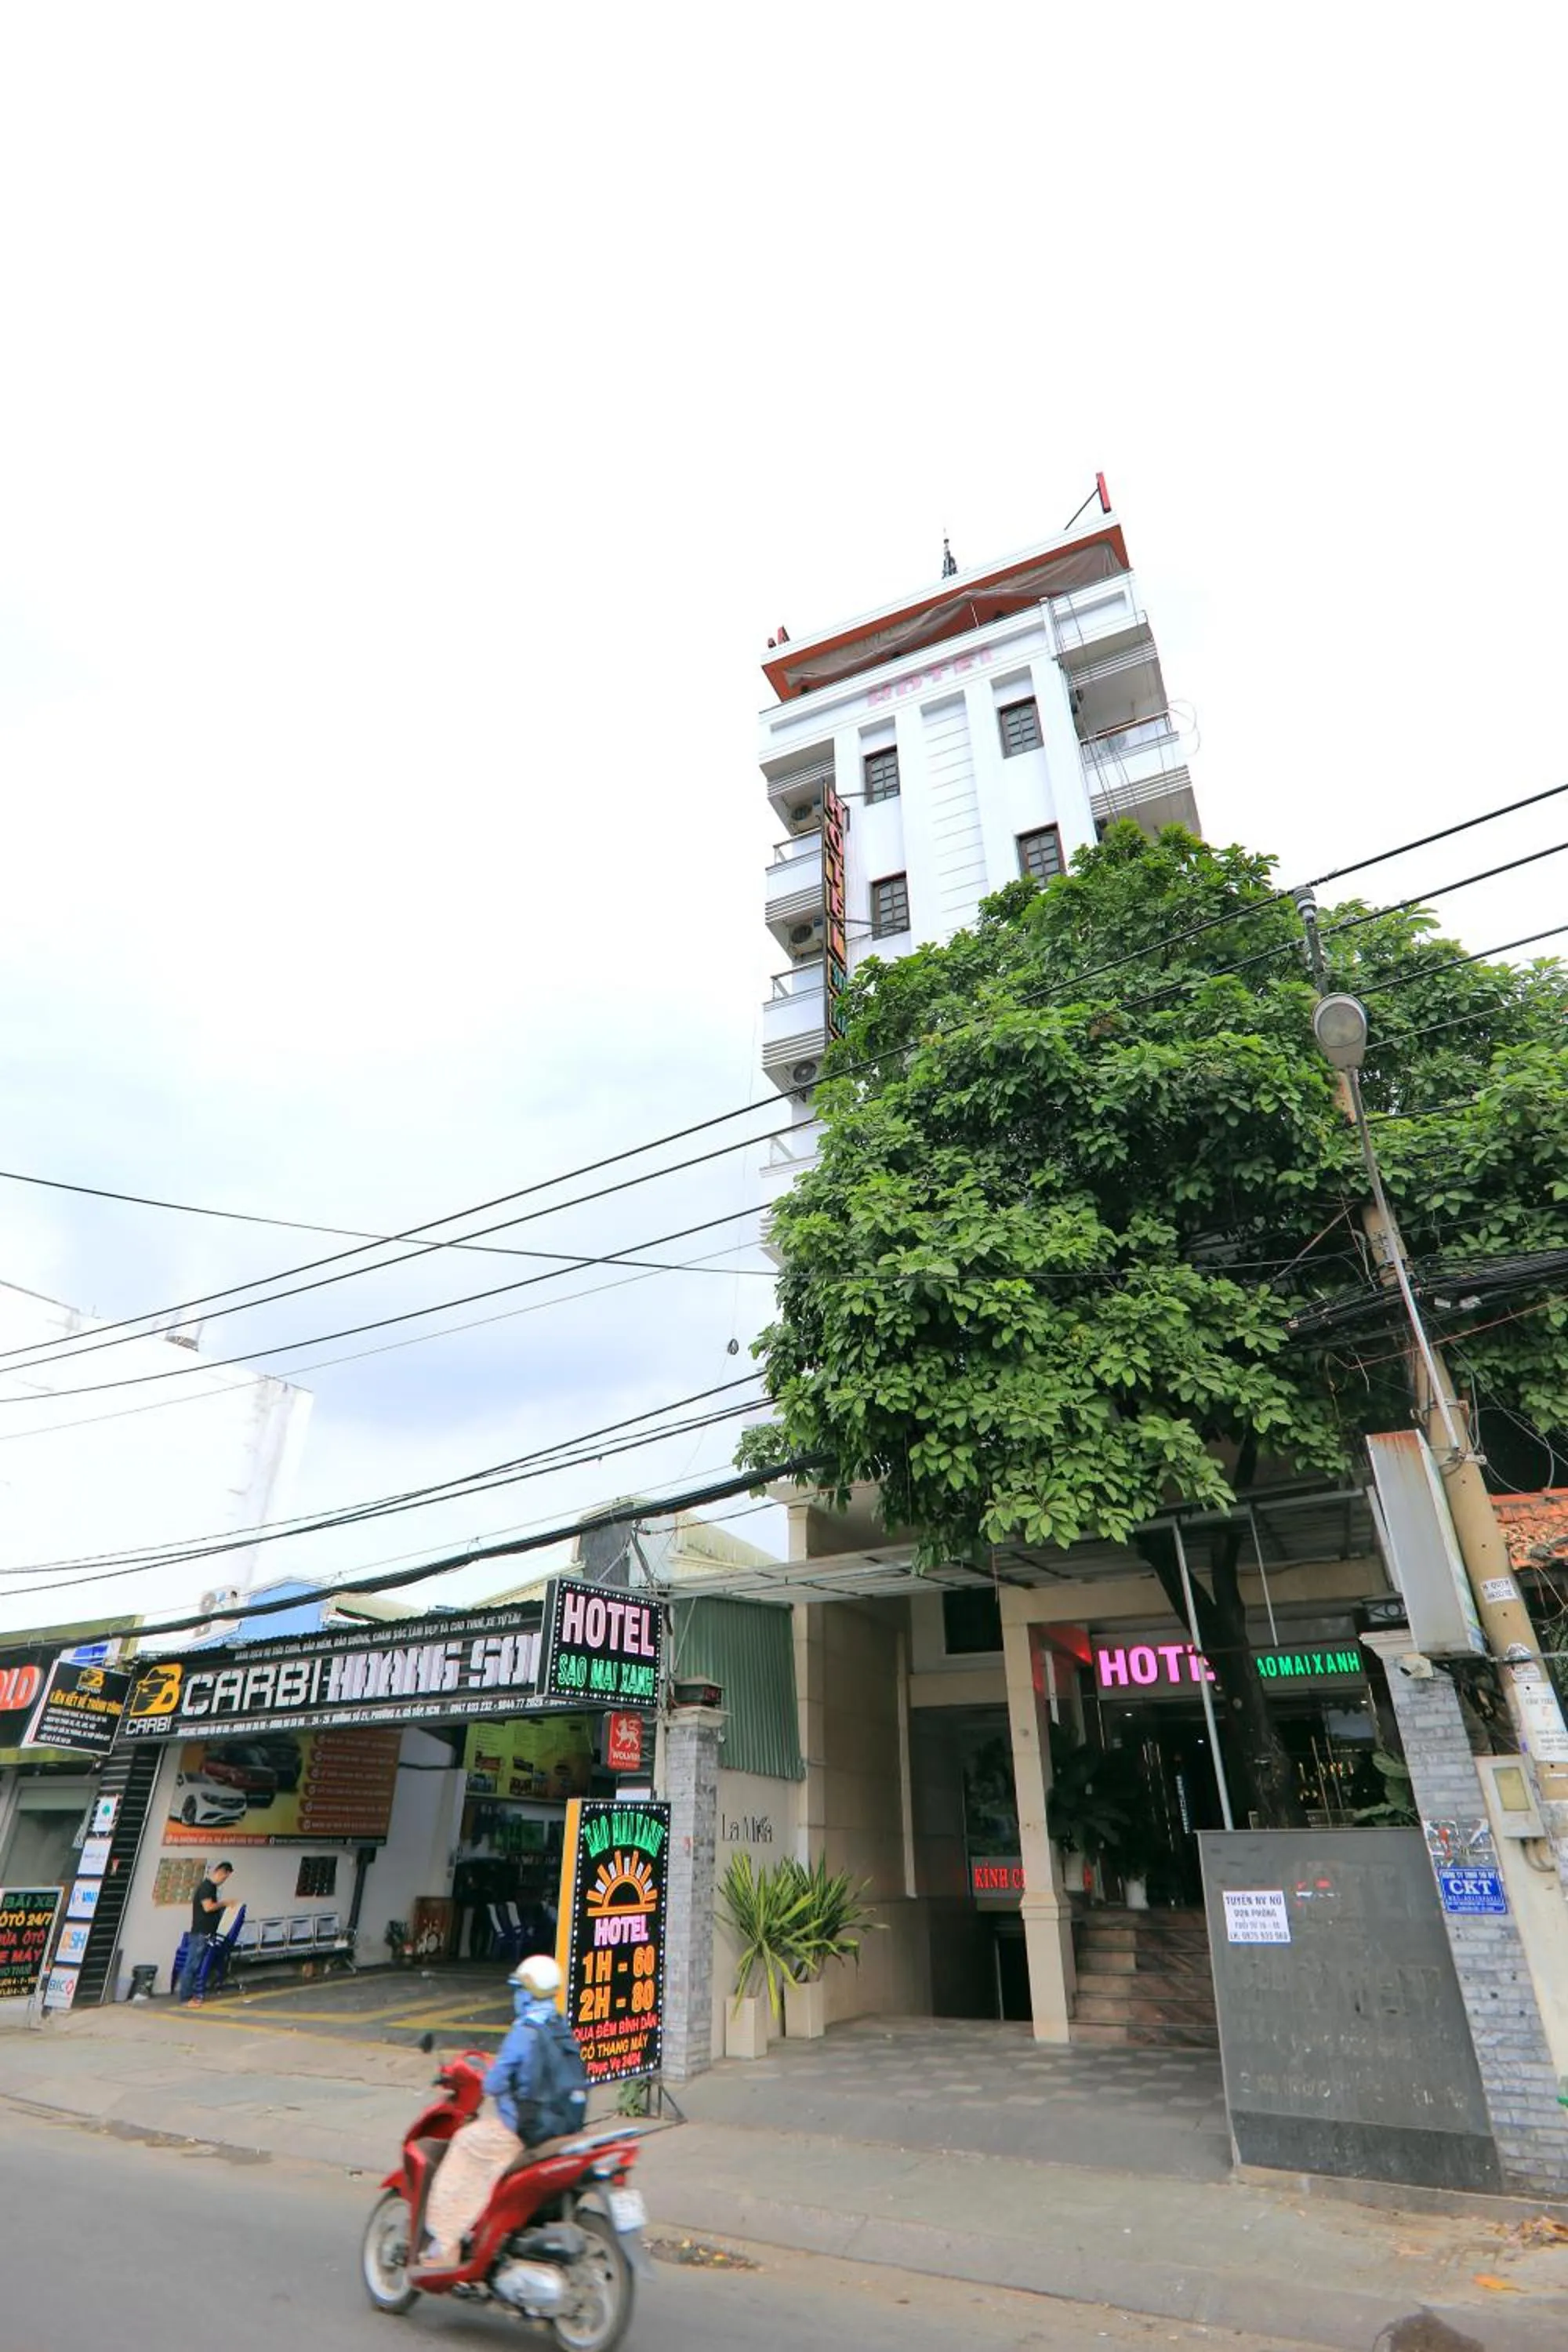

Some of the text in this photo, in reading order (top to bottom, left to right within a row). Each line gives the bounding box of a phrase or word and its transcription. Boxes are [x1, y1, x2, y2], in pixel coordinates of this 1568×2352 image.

[561, 1592, 655, 1657] HOTEL
[557, 1653, 655, 1697] SAO MAI XANH
[1098, 1644, 1215, 1686] HOTE
[181, 1658, 322, 1716] CARBI
[125, 1716, 172, 1735] CARBI
[3, 1893, 56, 1907] BÃI XE
[1449, 1879, 1493, 1895] CKT
[27, 1912, 53, 1926] 24/7
[594, 1914, 648, 1947] HOTEL
[583, 1950, 612, 1984] 1H
[633, 1945, 655, 1977] 60
[579, 1984, 611, 2022] 2H
[631, 1979, 655, 2013] 80
[573, 2027, 593, 2042] QUA
[596, 2020, 617, 2038] ĐÊM
[580, 2032, 648, 2060] CÓ THANG MÁY
